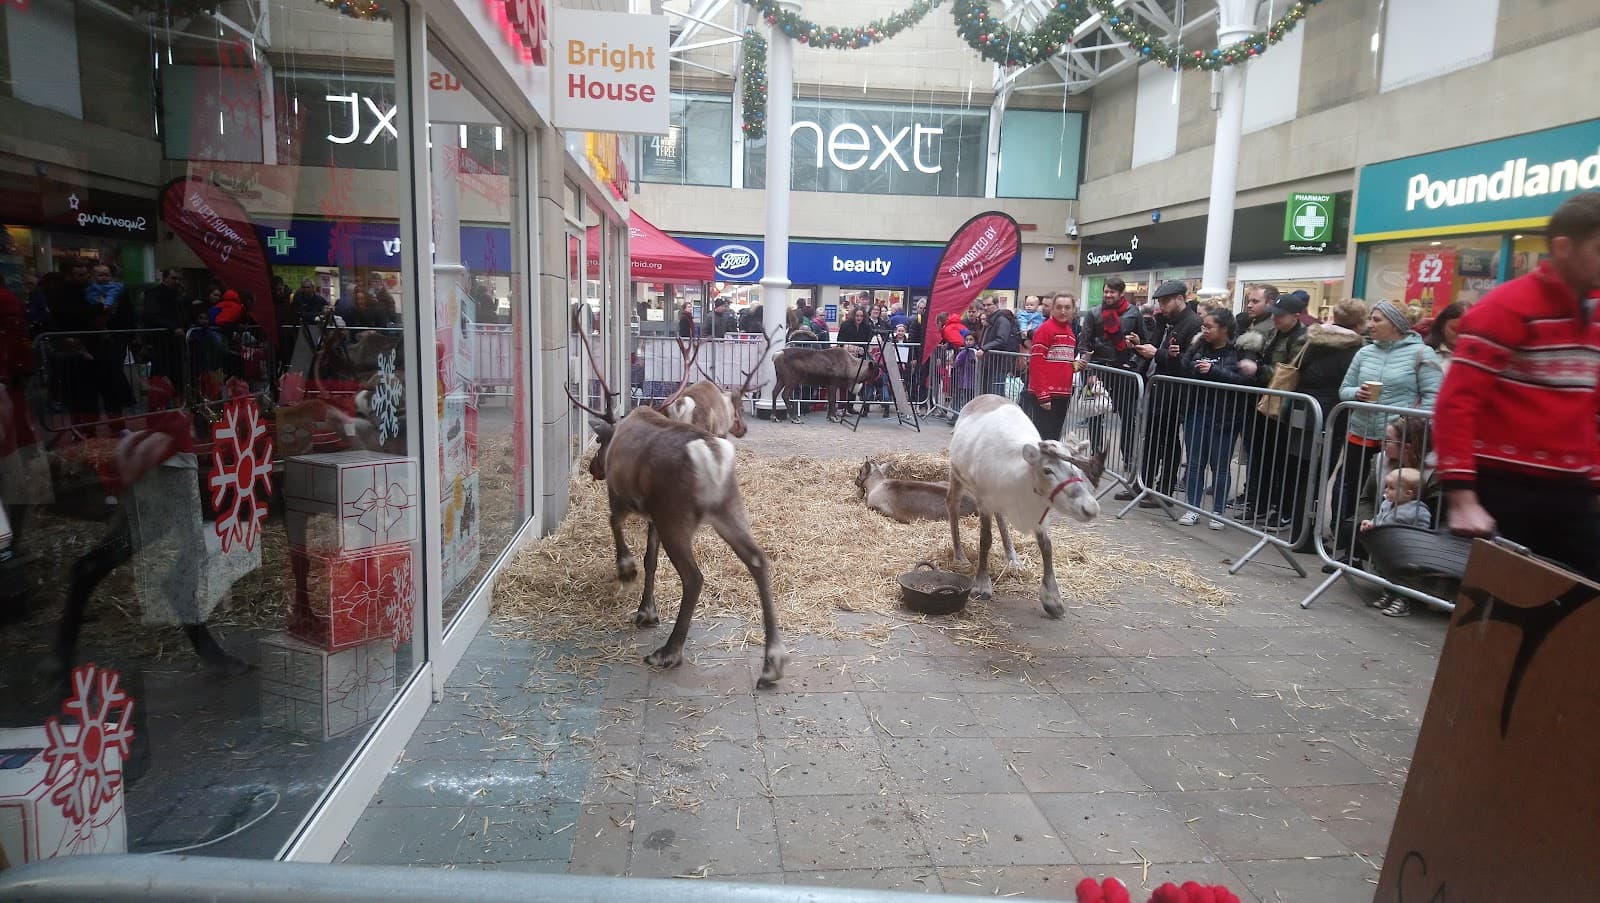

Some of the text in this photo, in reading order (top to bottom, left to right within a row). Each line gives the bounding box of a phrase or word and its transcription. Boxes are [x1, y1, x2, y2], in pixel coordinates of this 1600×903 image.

[568, 39, 655, 73] Bright
[568, 73, 656, 103] House
[790, 120, 944, 174] next
[1405, 144, 1600, 212] Poundland
[1295, 194, 1331, 202] PHARMACY
[718, 252, 751, 271] Boots
[948, 236, 989, 277] SUPPORTED
[984, 225, 997, 240] BY
[1086, 250, 1134, 266] Superdrug
[631, 260, 663, 270] rbid.org
[832, 255, 892, 276] beauty
[1418, 258, 1444, 283] £2
